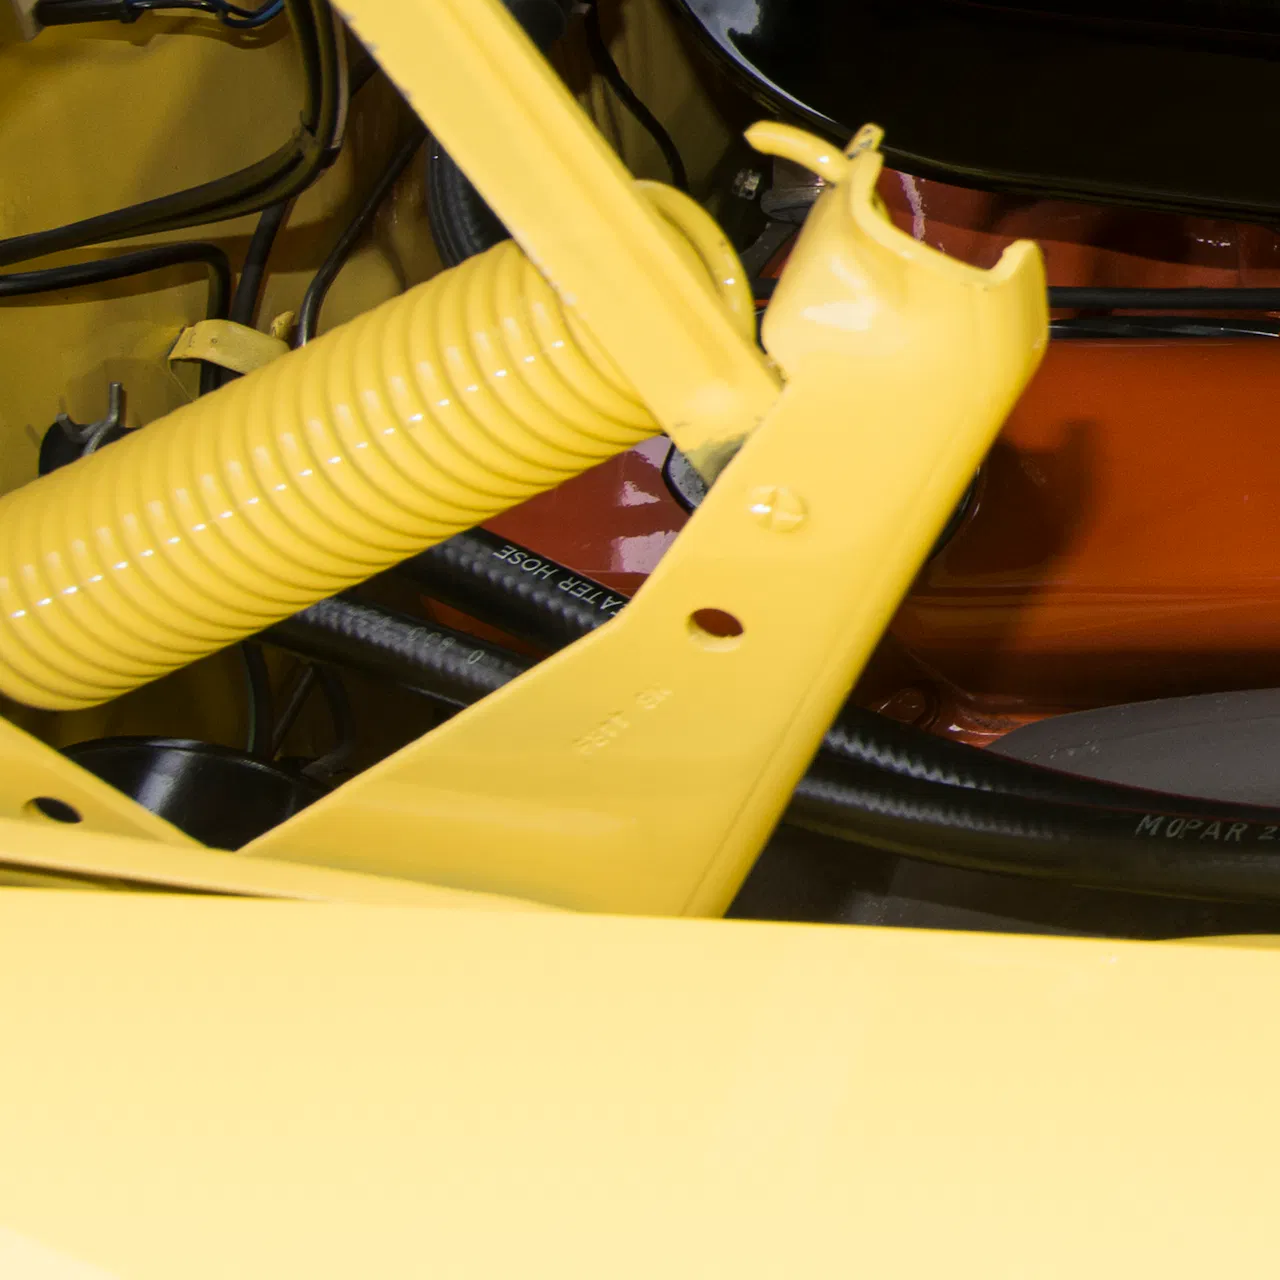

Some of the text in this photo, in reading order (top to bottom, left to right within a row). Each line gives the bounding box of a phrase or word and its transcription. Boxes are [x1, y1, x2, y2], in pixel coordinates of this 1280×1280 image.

[492, 545, 624, 617] ATER HOSE
[1134, 813, 1249, 844] MOPAR
